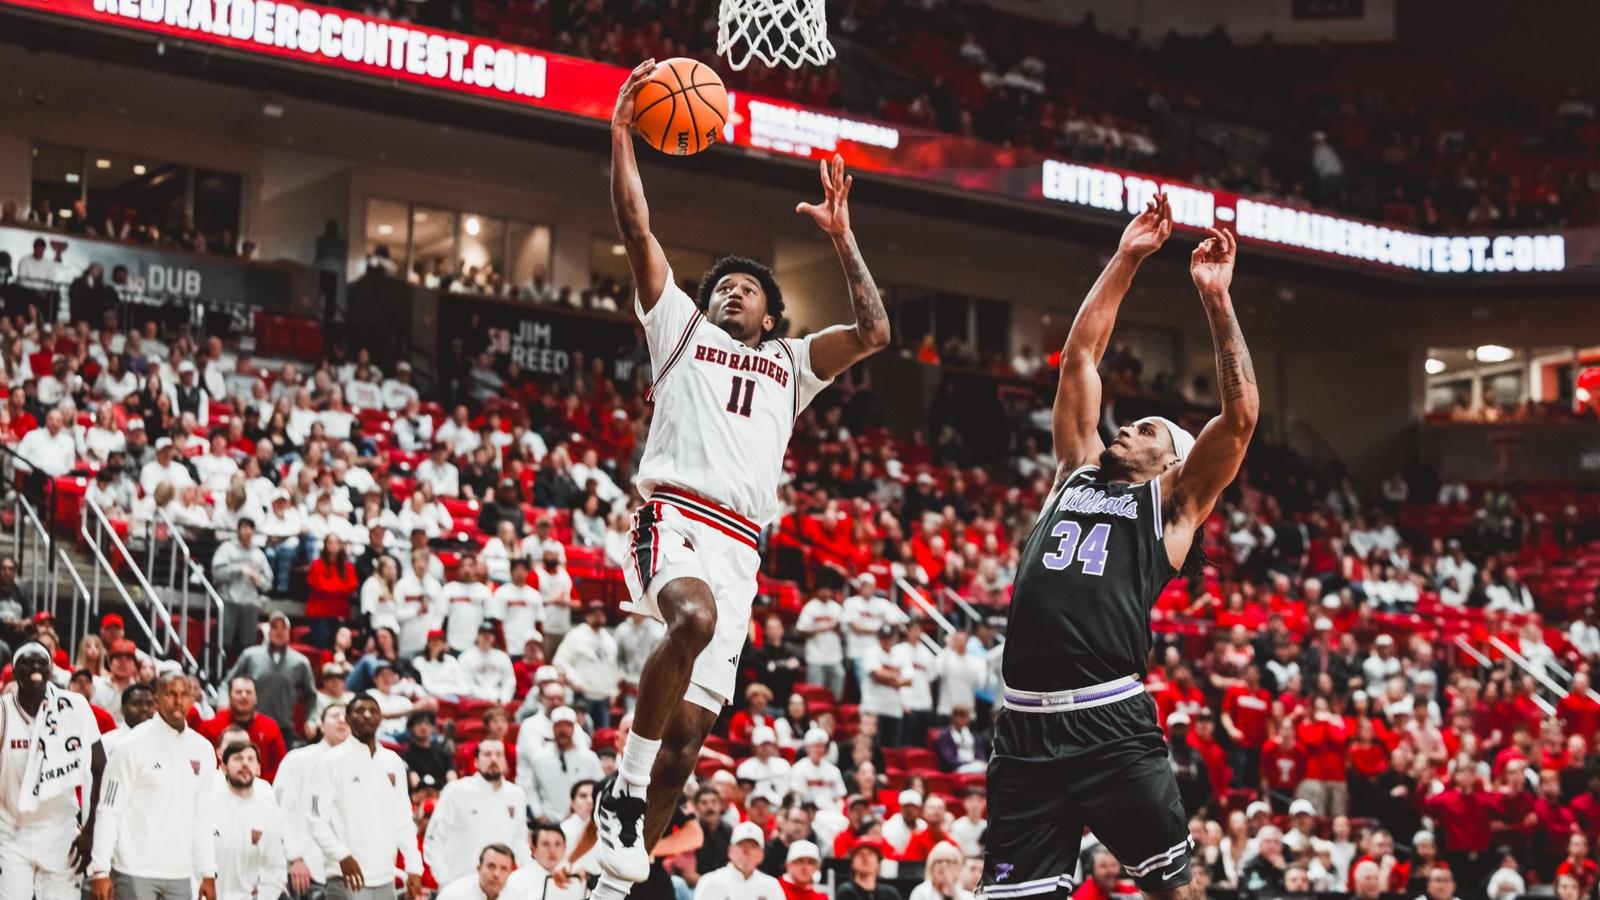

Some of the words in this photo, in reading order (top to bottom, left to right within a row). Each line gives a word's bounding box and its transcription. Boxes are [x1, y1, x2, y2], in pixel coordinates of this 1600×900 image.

[1042, 159, 1123, 212] ENTER
[1236, 199, 1565, 273] REDRAIDERSCONTEST.COM
[148, 264, 201, 296] DUB
[513, 320, 552, 346] JIM
[511, 346, 569, 375] REED
[694, 344, 728, 366] RED
[728, 353, 789, 389] RAIDERS
[726, 375, 756, 418] 11
[1042, 520, 1111, 576] 34
